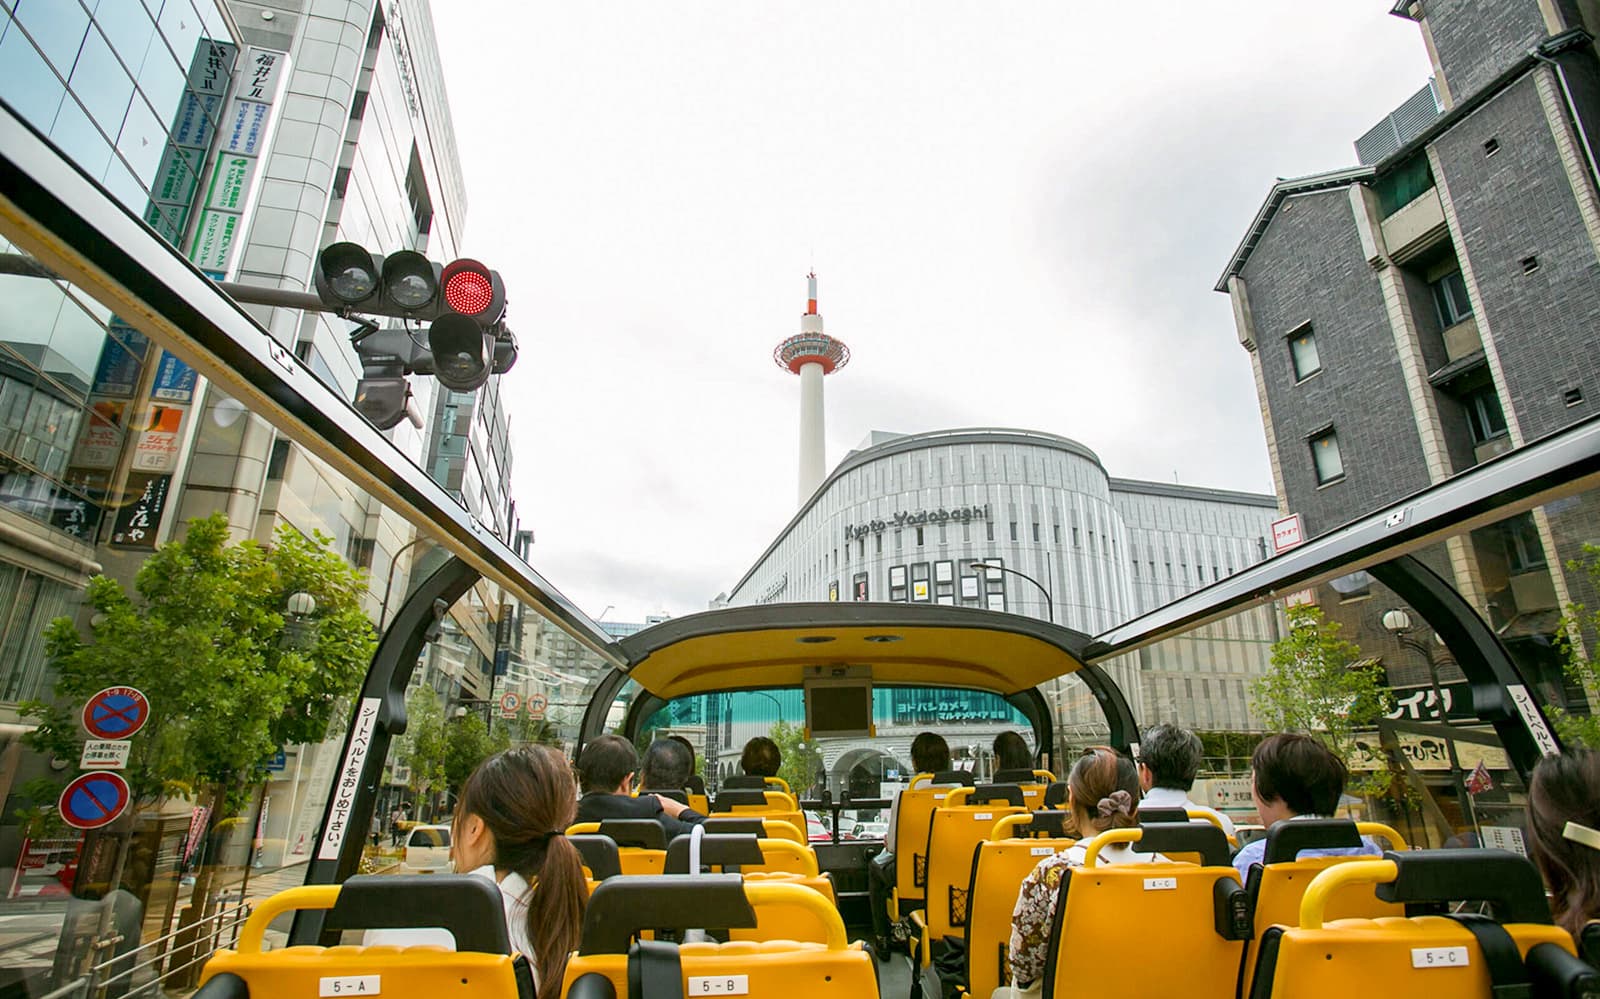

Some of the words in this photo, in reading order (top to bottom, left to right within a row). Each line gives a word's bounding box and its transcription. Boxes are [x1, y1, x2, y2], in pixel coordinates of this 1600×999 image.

[248, 54, 276, 99] 福井ビル
[844, 503, 988, 540] Kyoto-Yodobashi
[897, 701, 969, 713] ヨドバシカメラ
[1515, 694, 1552, 752] シートベルト
[327, 707, 375, 847] シートベルトをおしめ下さい。
